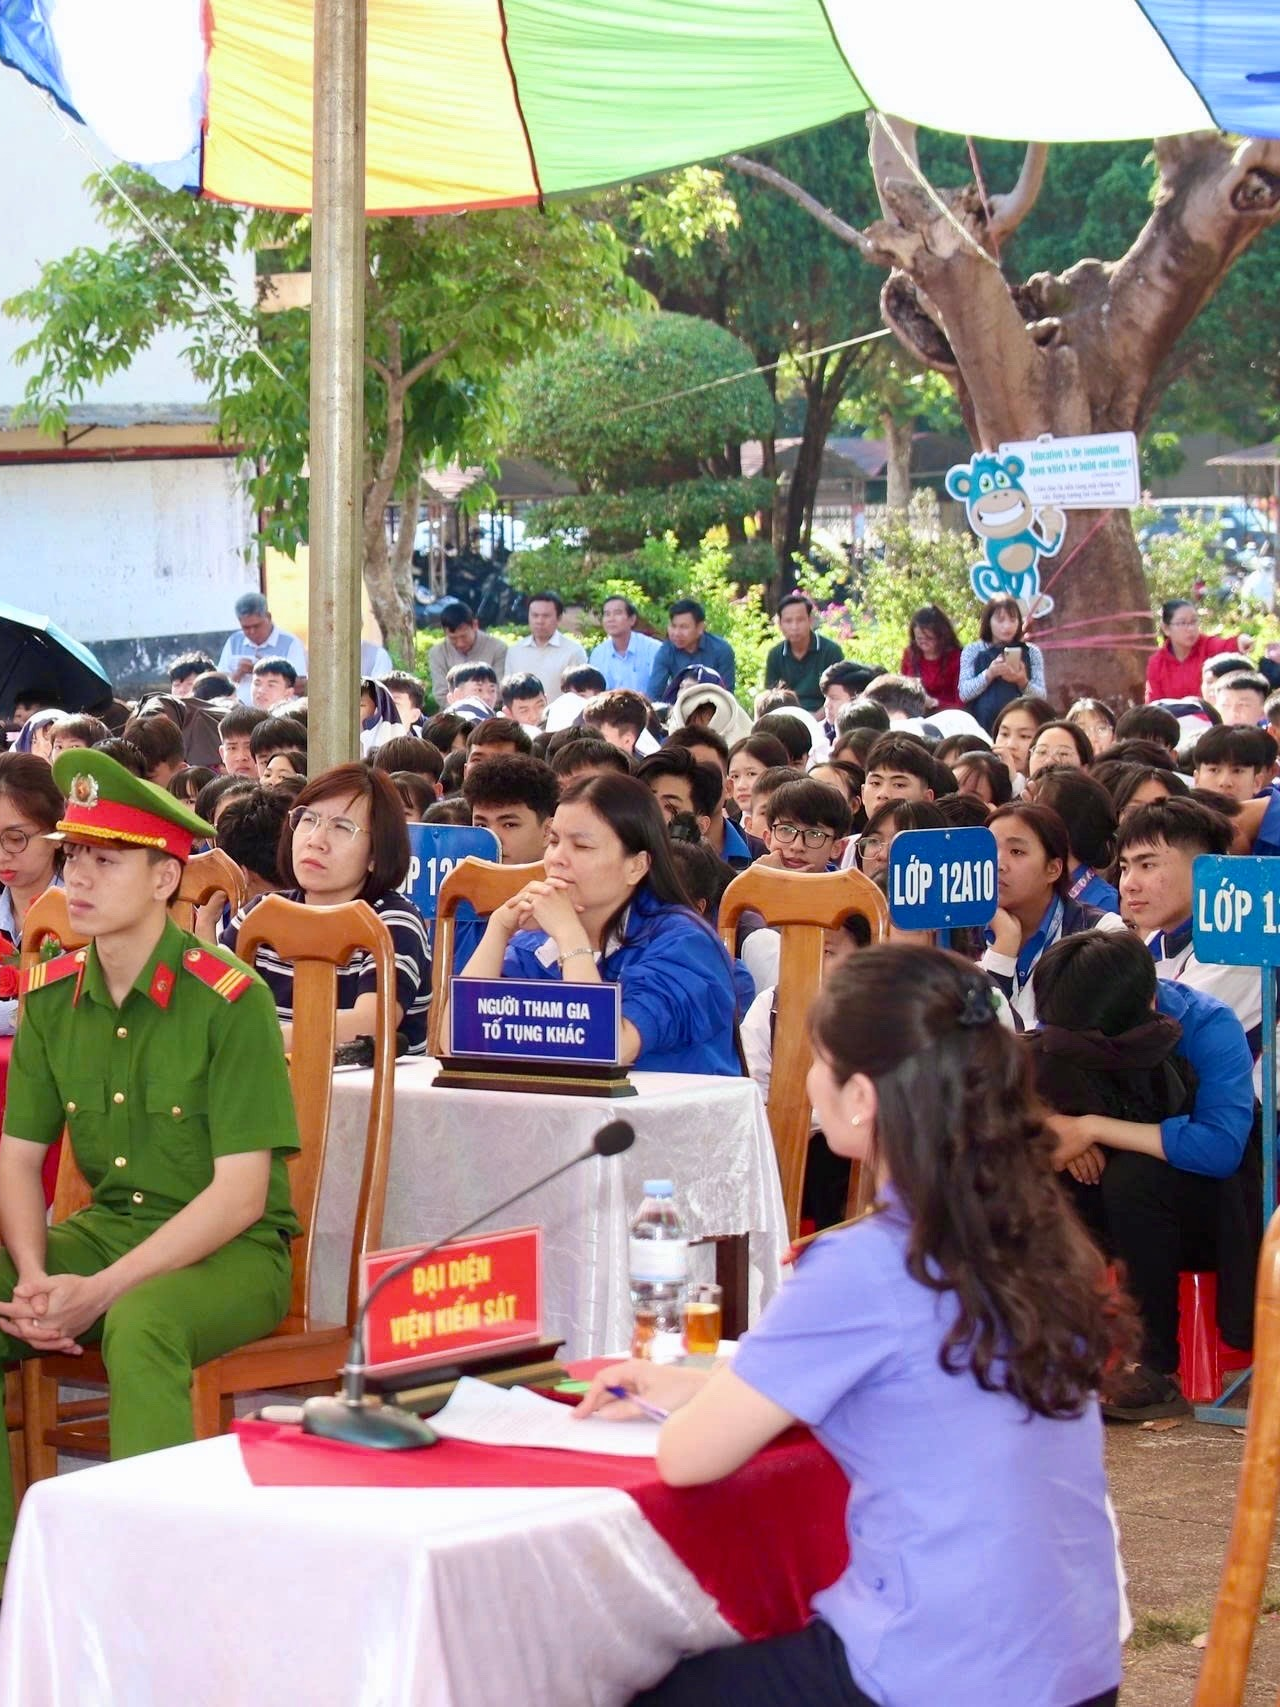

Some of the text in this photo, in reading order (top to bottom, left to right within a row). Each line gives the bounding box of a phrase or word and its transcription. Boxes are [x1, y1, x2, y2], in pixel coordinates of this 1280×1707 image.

[894, 854, 994, 906] LỚP 12A10
[1199, 877, 1280, 934] LỚP 1
[477, 995, 591, 1020] NGƯỜI THAM GIA
[482, 1017, 585, 1045] TỐ TỤNG KHÁC
[412, 1252, 492, 1299] ĐẠI DIỆN
[390, 1291, 518, 1348] VIỆN KIỂM SÁT
